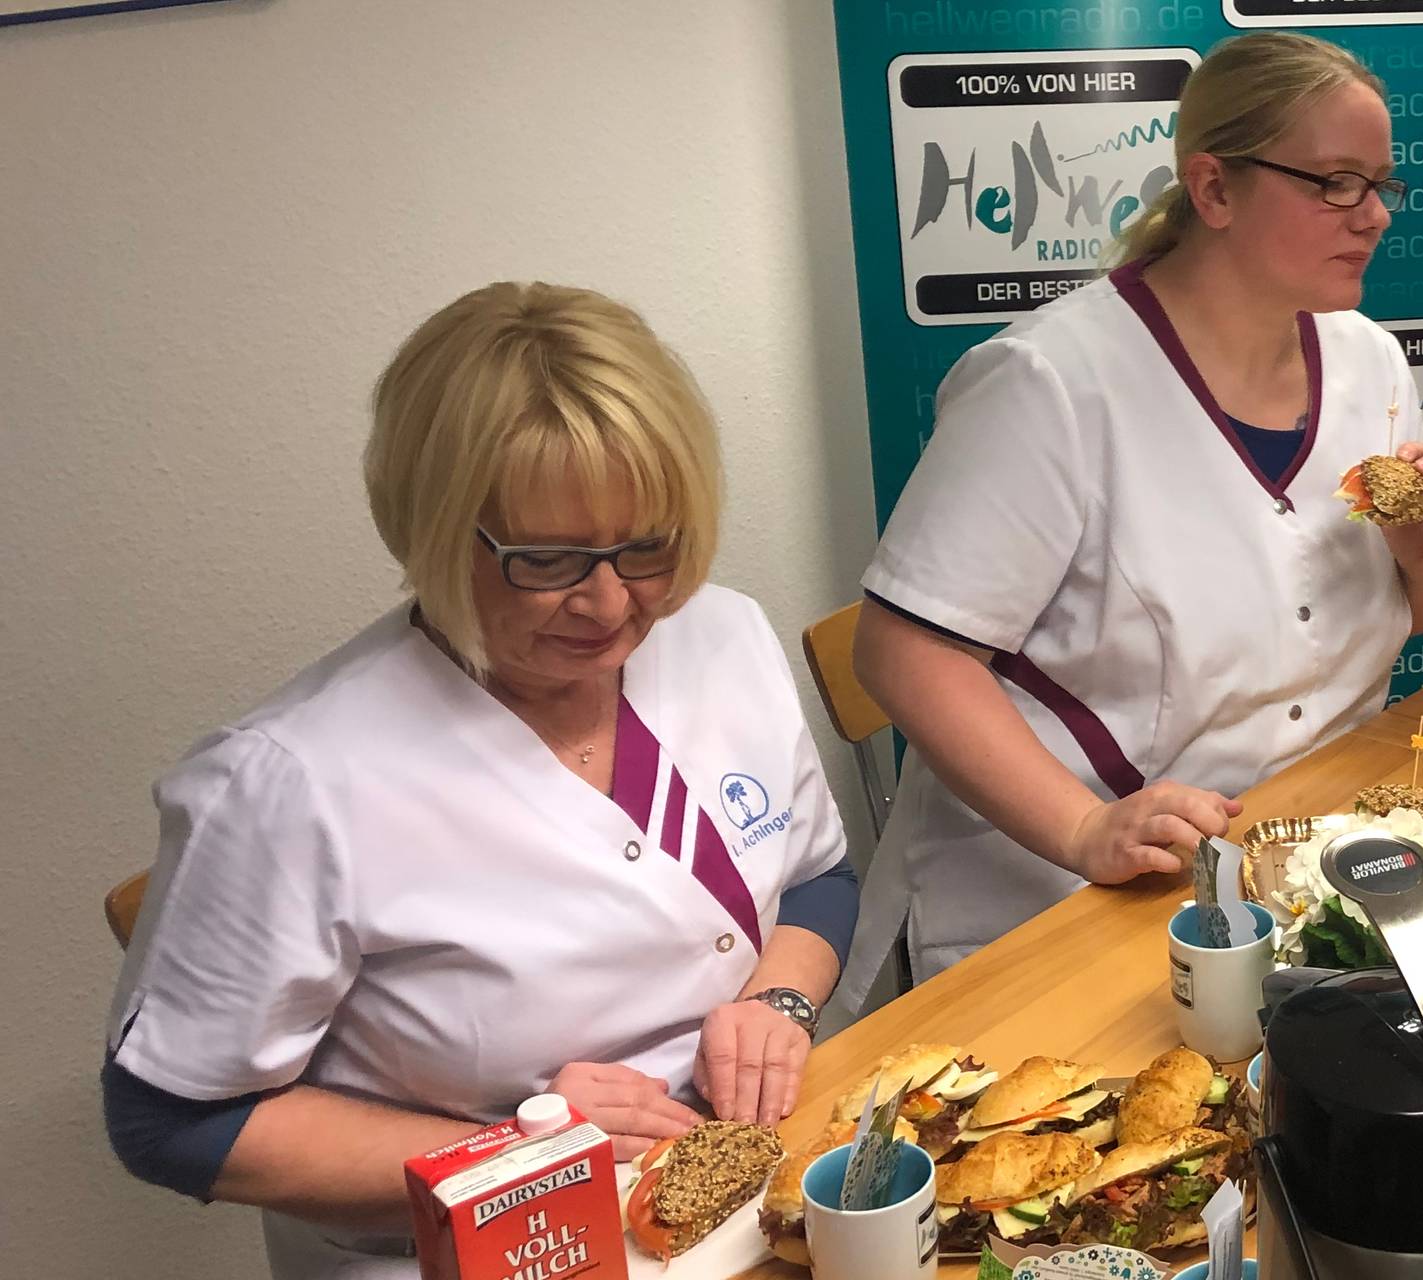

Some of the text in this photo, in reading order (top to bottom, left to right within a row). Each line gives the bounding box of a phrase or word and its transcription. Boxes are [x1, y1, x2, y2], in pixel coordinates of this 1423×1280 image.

[956, 72, 1136, 95] 100% VON HIER
[977, 280, 1094, 302] DER BEST
[742, 806, 793, 851] Achinger
[1350, 854, 1403, 873] BONAMAT
[1352, 861, 1406, 880] BRAVILOR
[478, 1163, 588, 1221] DAIRYSTAR
[527, 1210, 549, 1235] H
[504, 1224, 588, 1268] VOLL-
